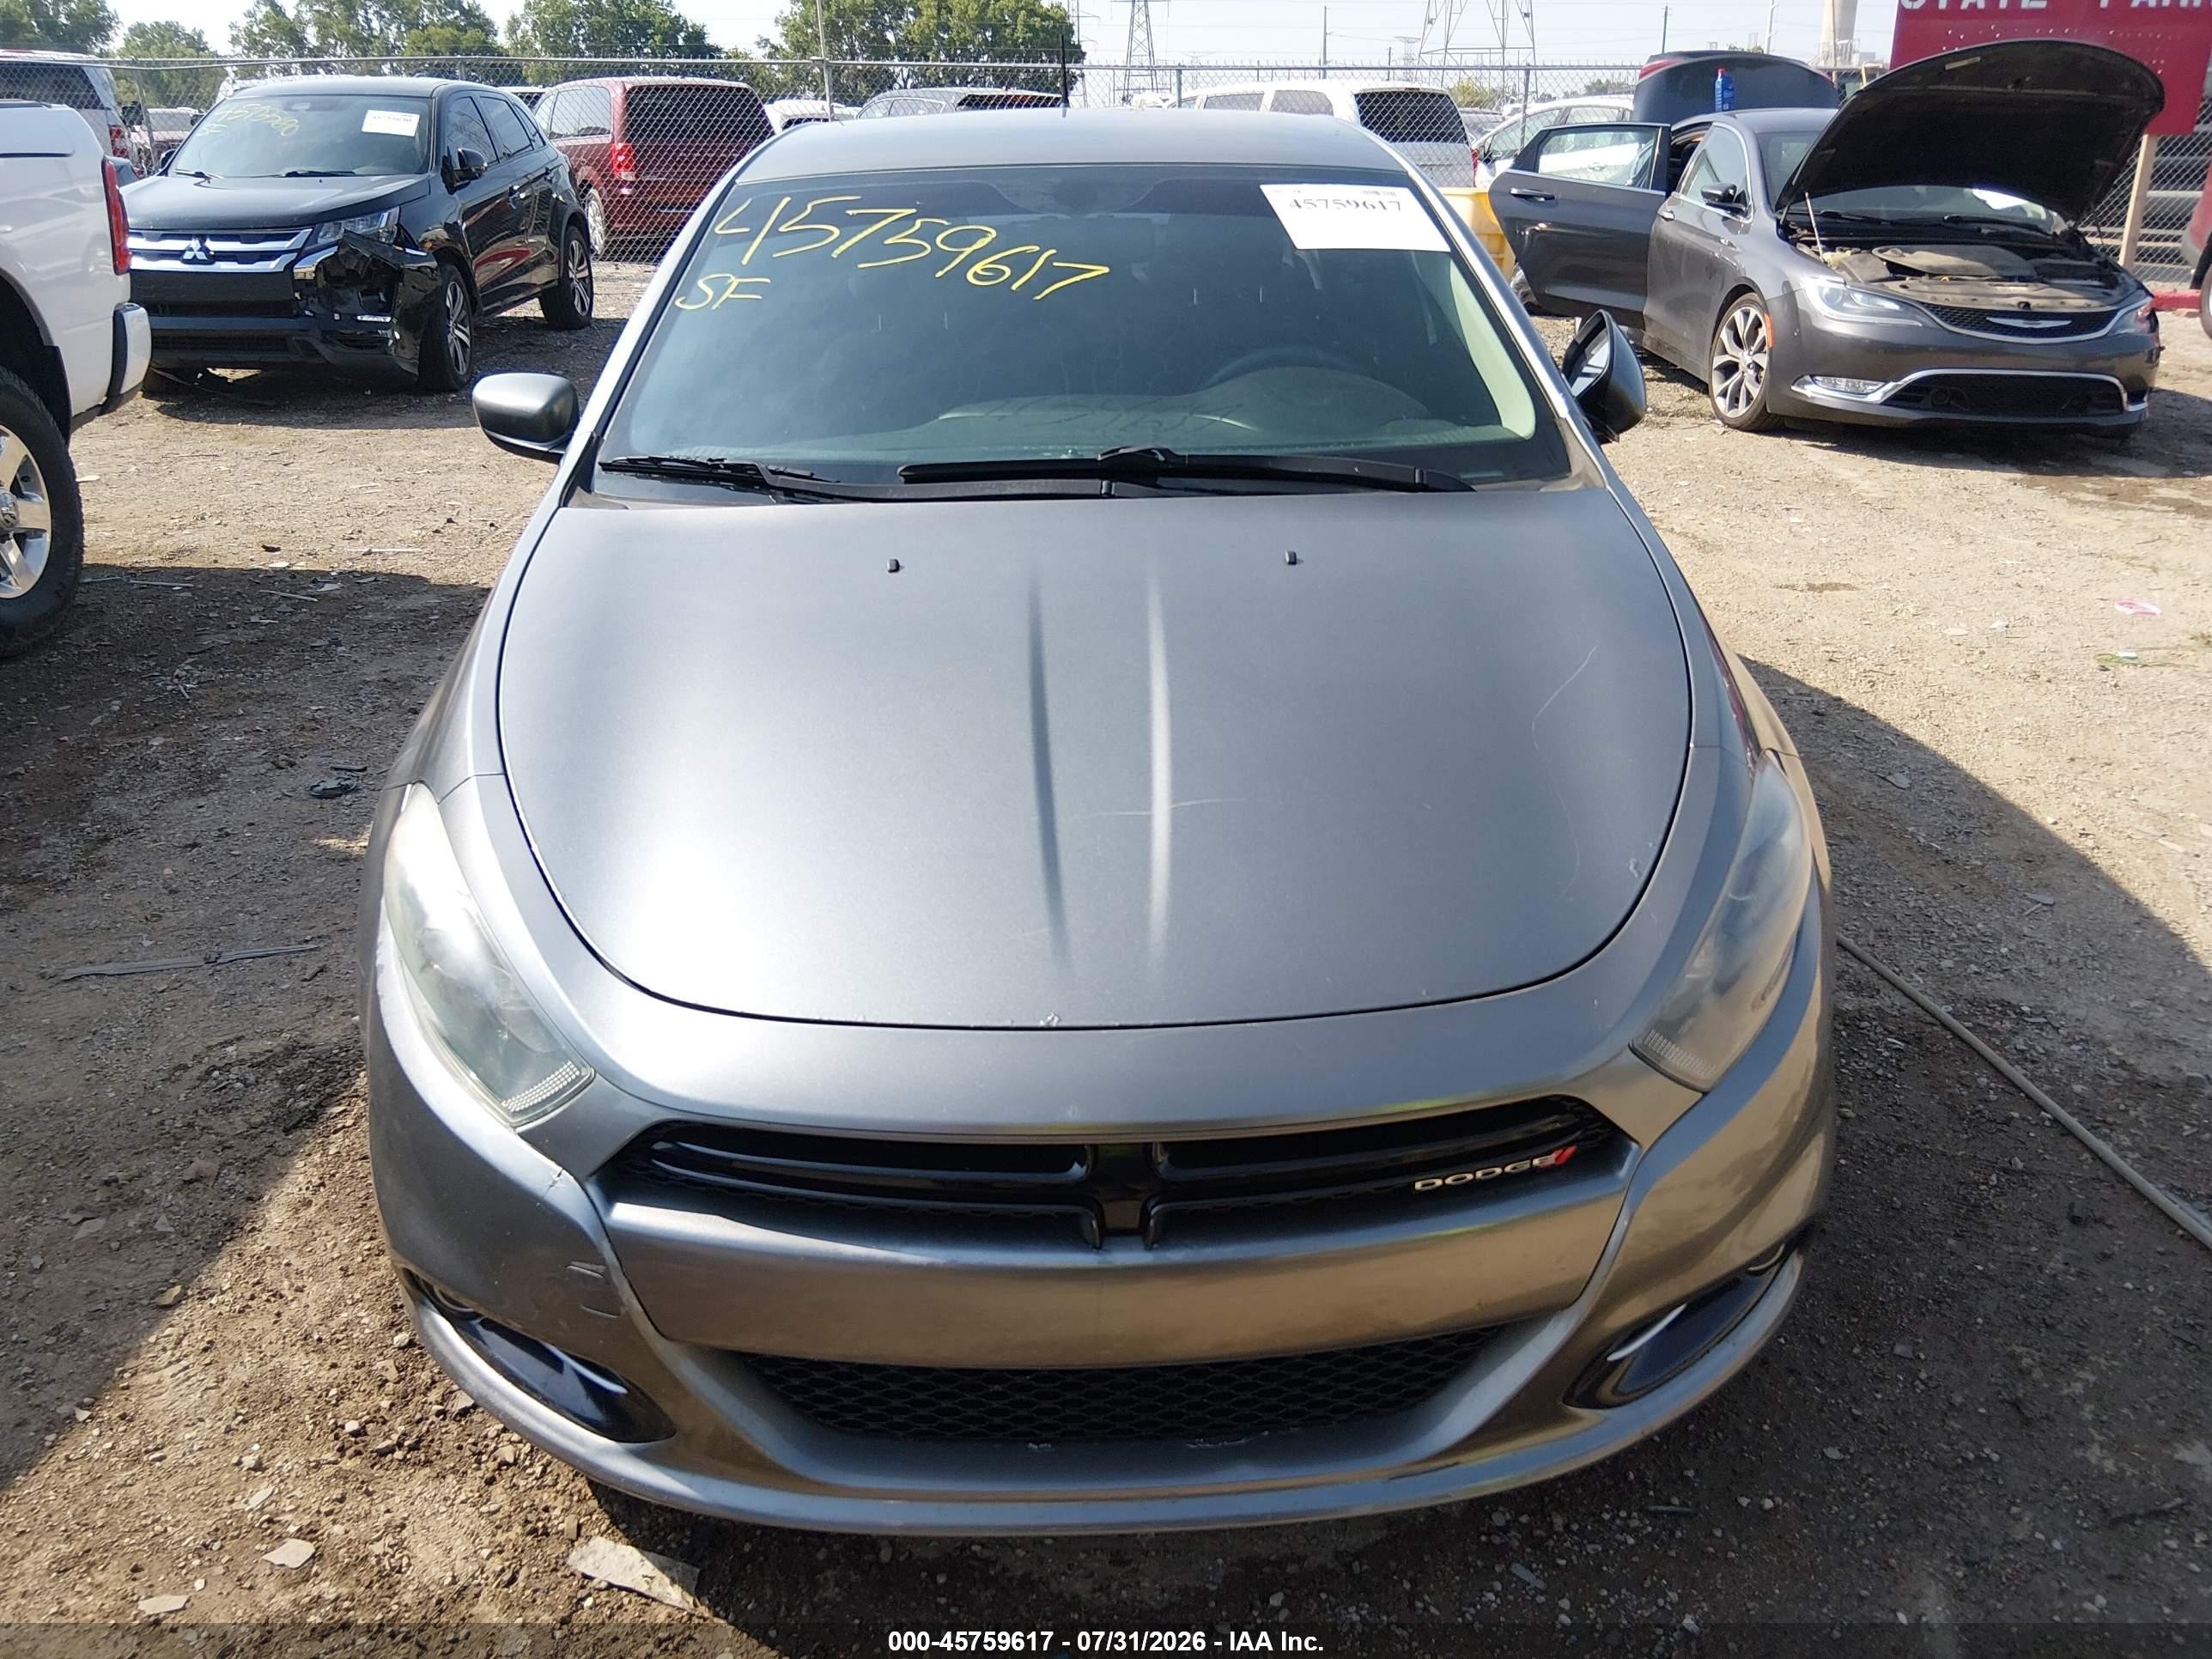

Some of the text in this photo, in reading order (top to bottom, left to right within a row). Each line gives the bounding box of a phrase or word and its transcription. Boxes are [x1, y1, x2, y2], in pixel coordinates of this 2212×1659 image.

[1289, 198, 1401, 211] 45759617
[713, 195, 1110, 301] 45759617
[674, 273, 771, 311] SF
[1414, 1153, 1557, 1191] DODGE
